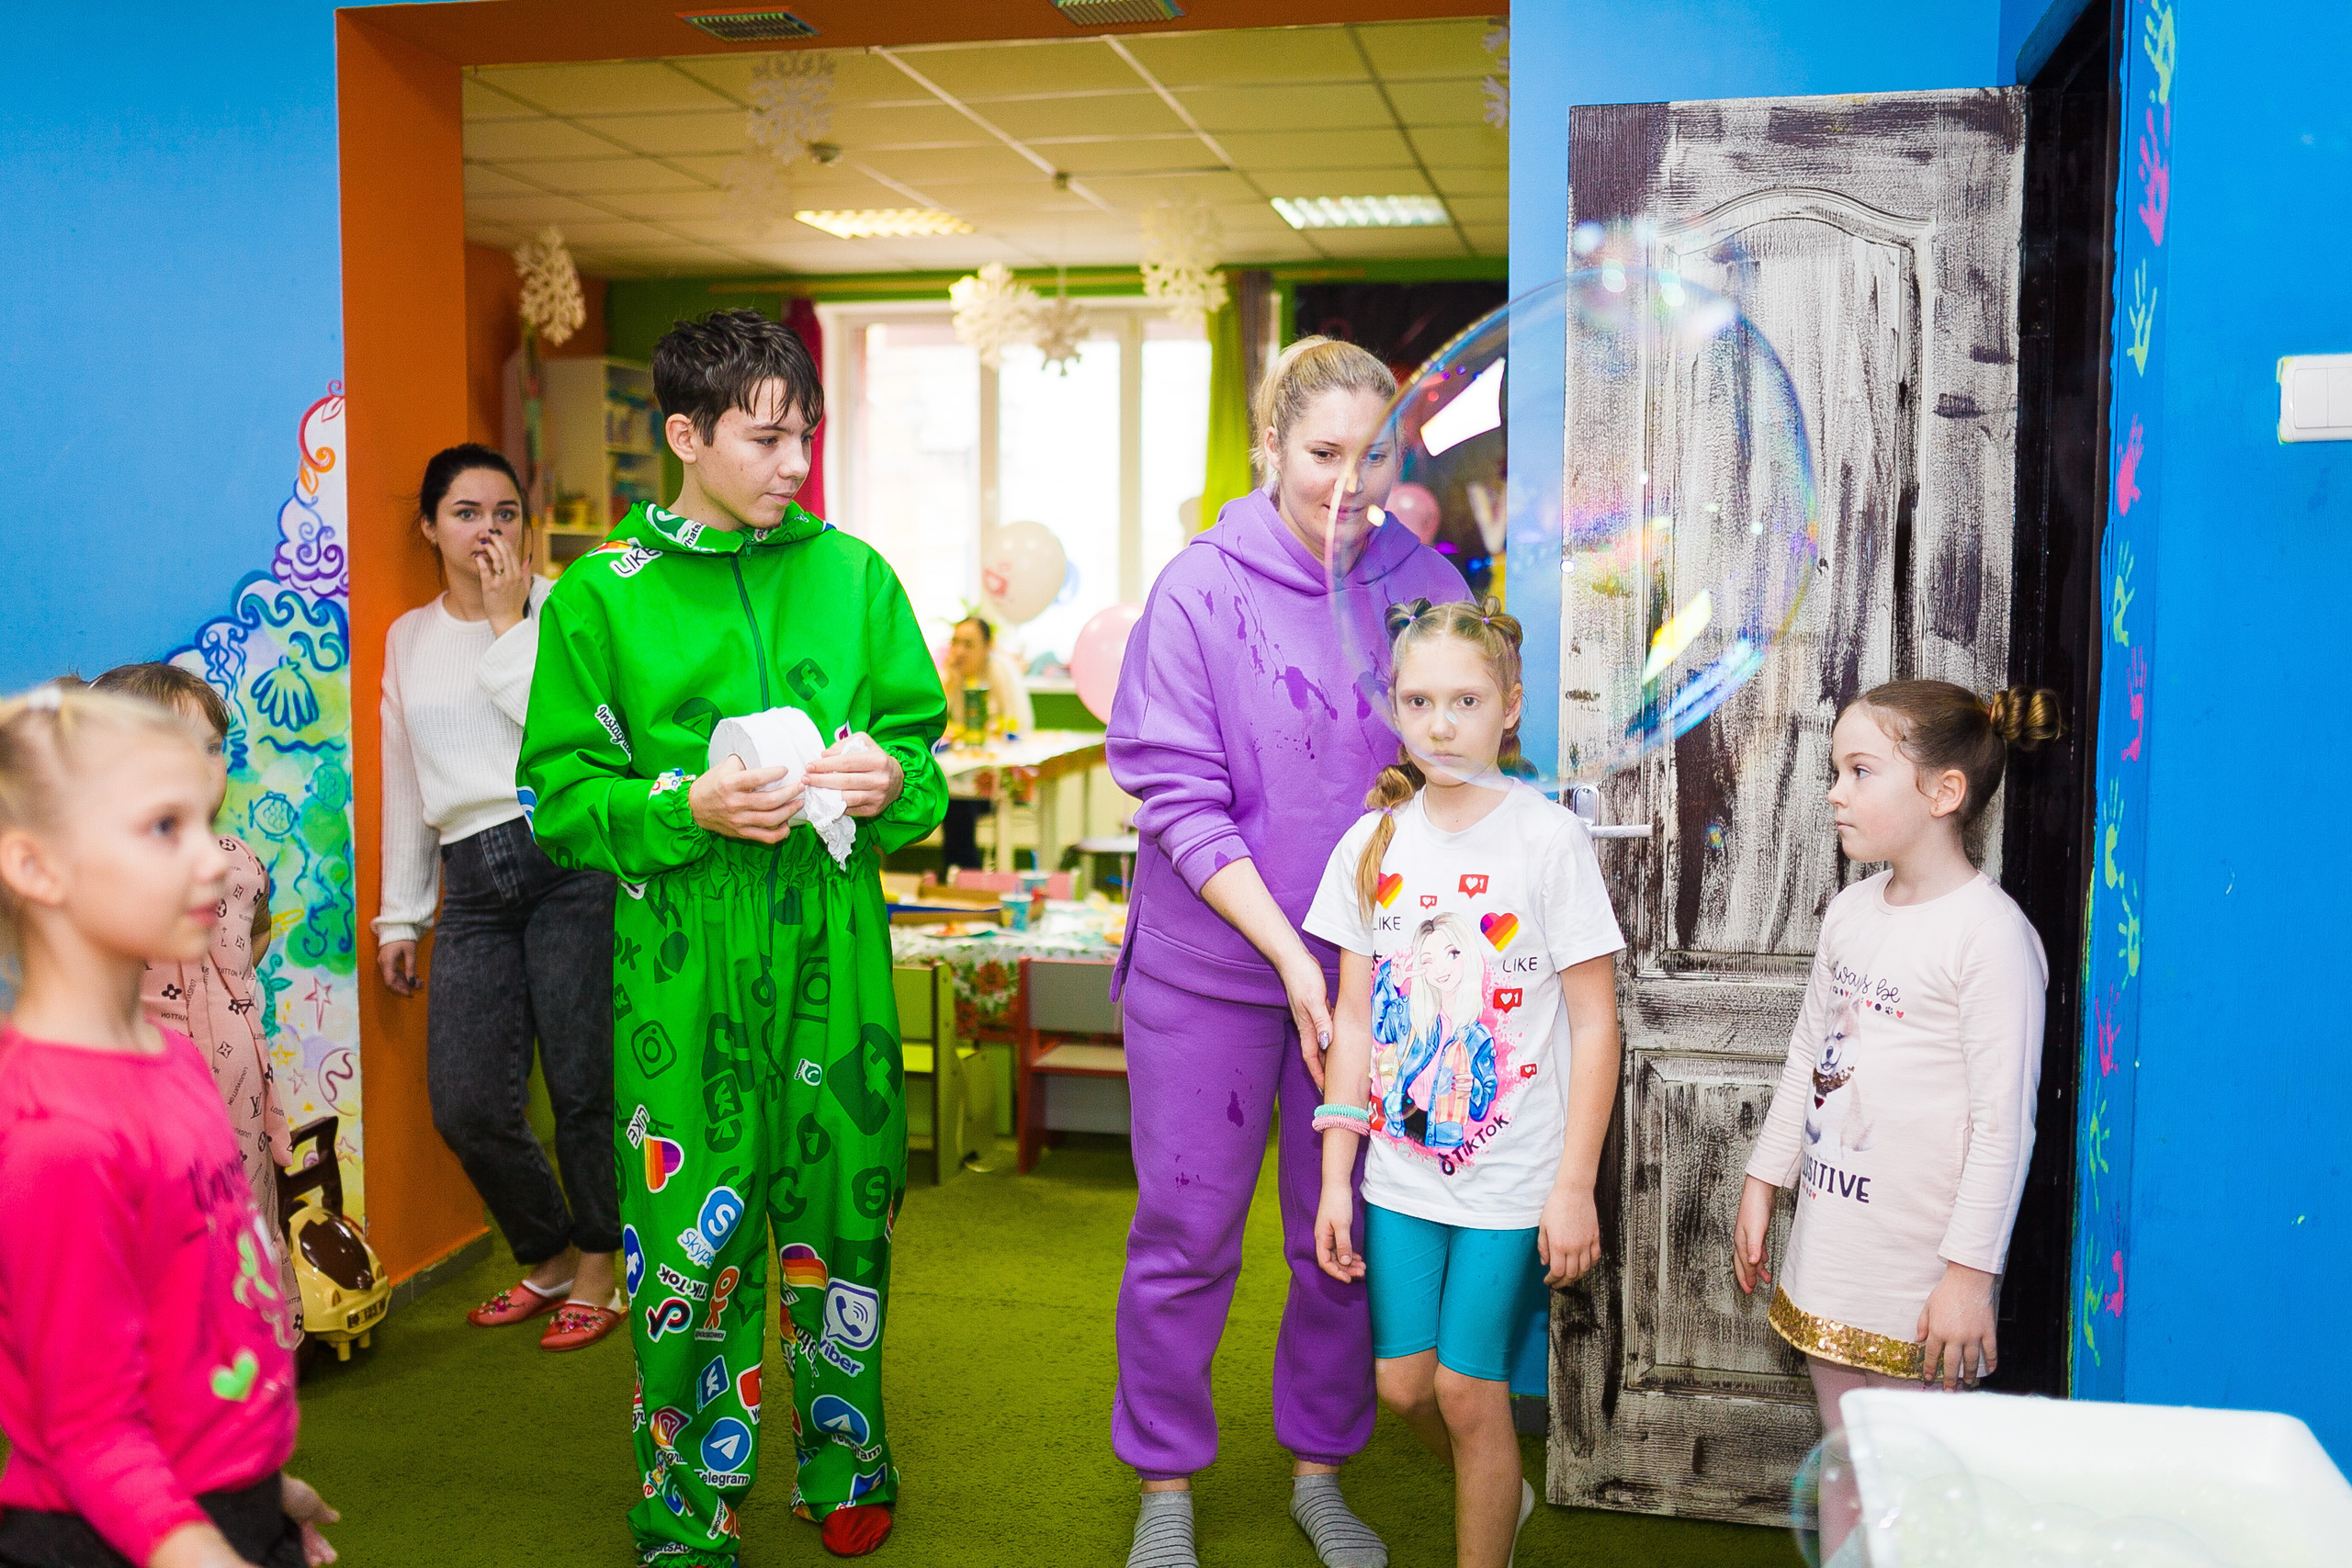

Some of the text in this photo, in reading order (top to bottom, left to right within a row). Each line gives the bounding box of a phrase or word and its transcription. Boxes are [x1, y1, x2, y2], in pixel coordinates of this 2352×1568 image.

[1502, 956, 1538, 973] LIKE
[1876, 978, 1901, 1003] be
[628, 1108, 646, 1146] LIKE
[681, 1231, 715, 1266] Skype
[659, 1266, 688, 1293] Tok
